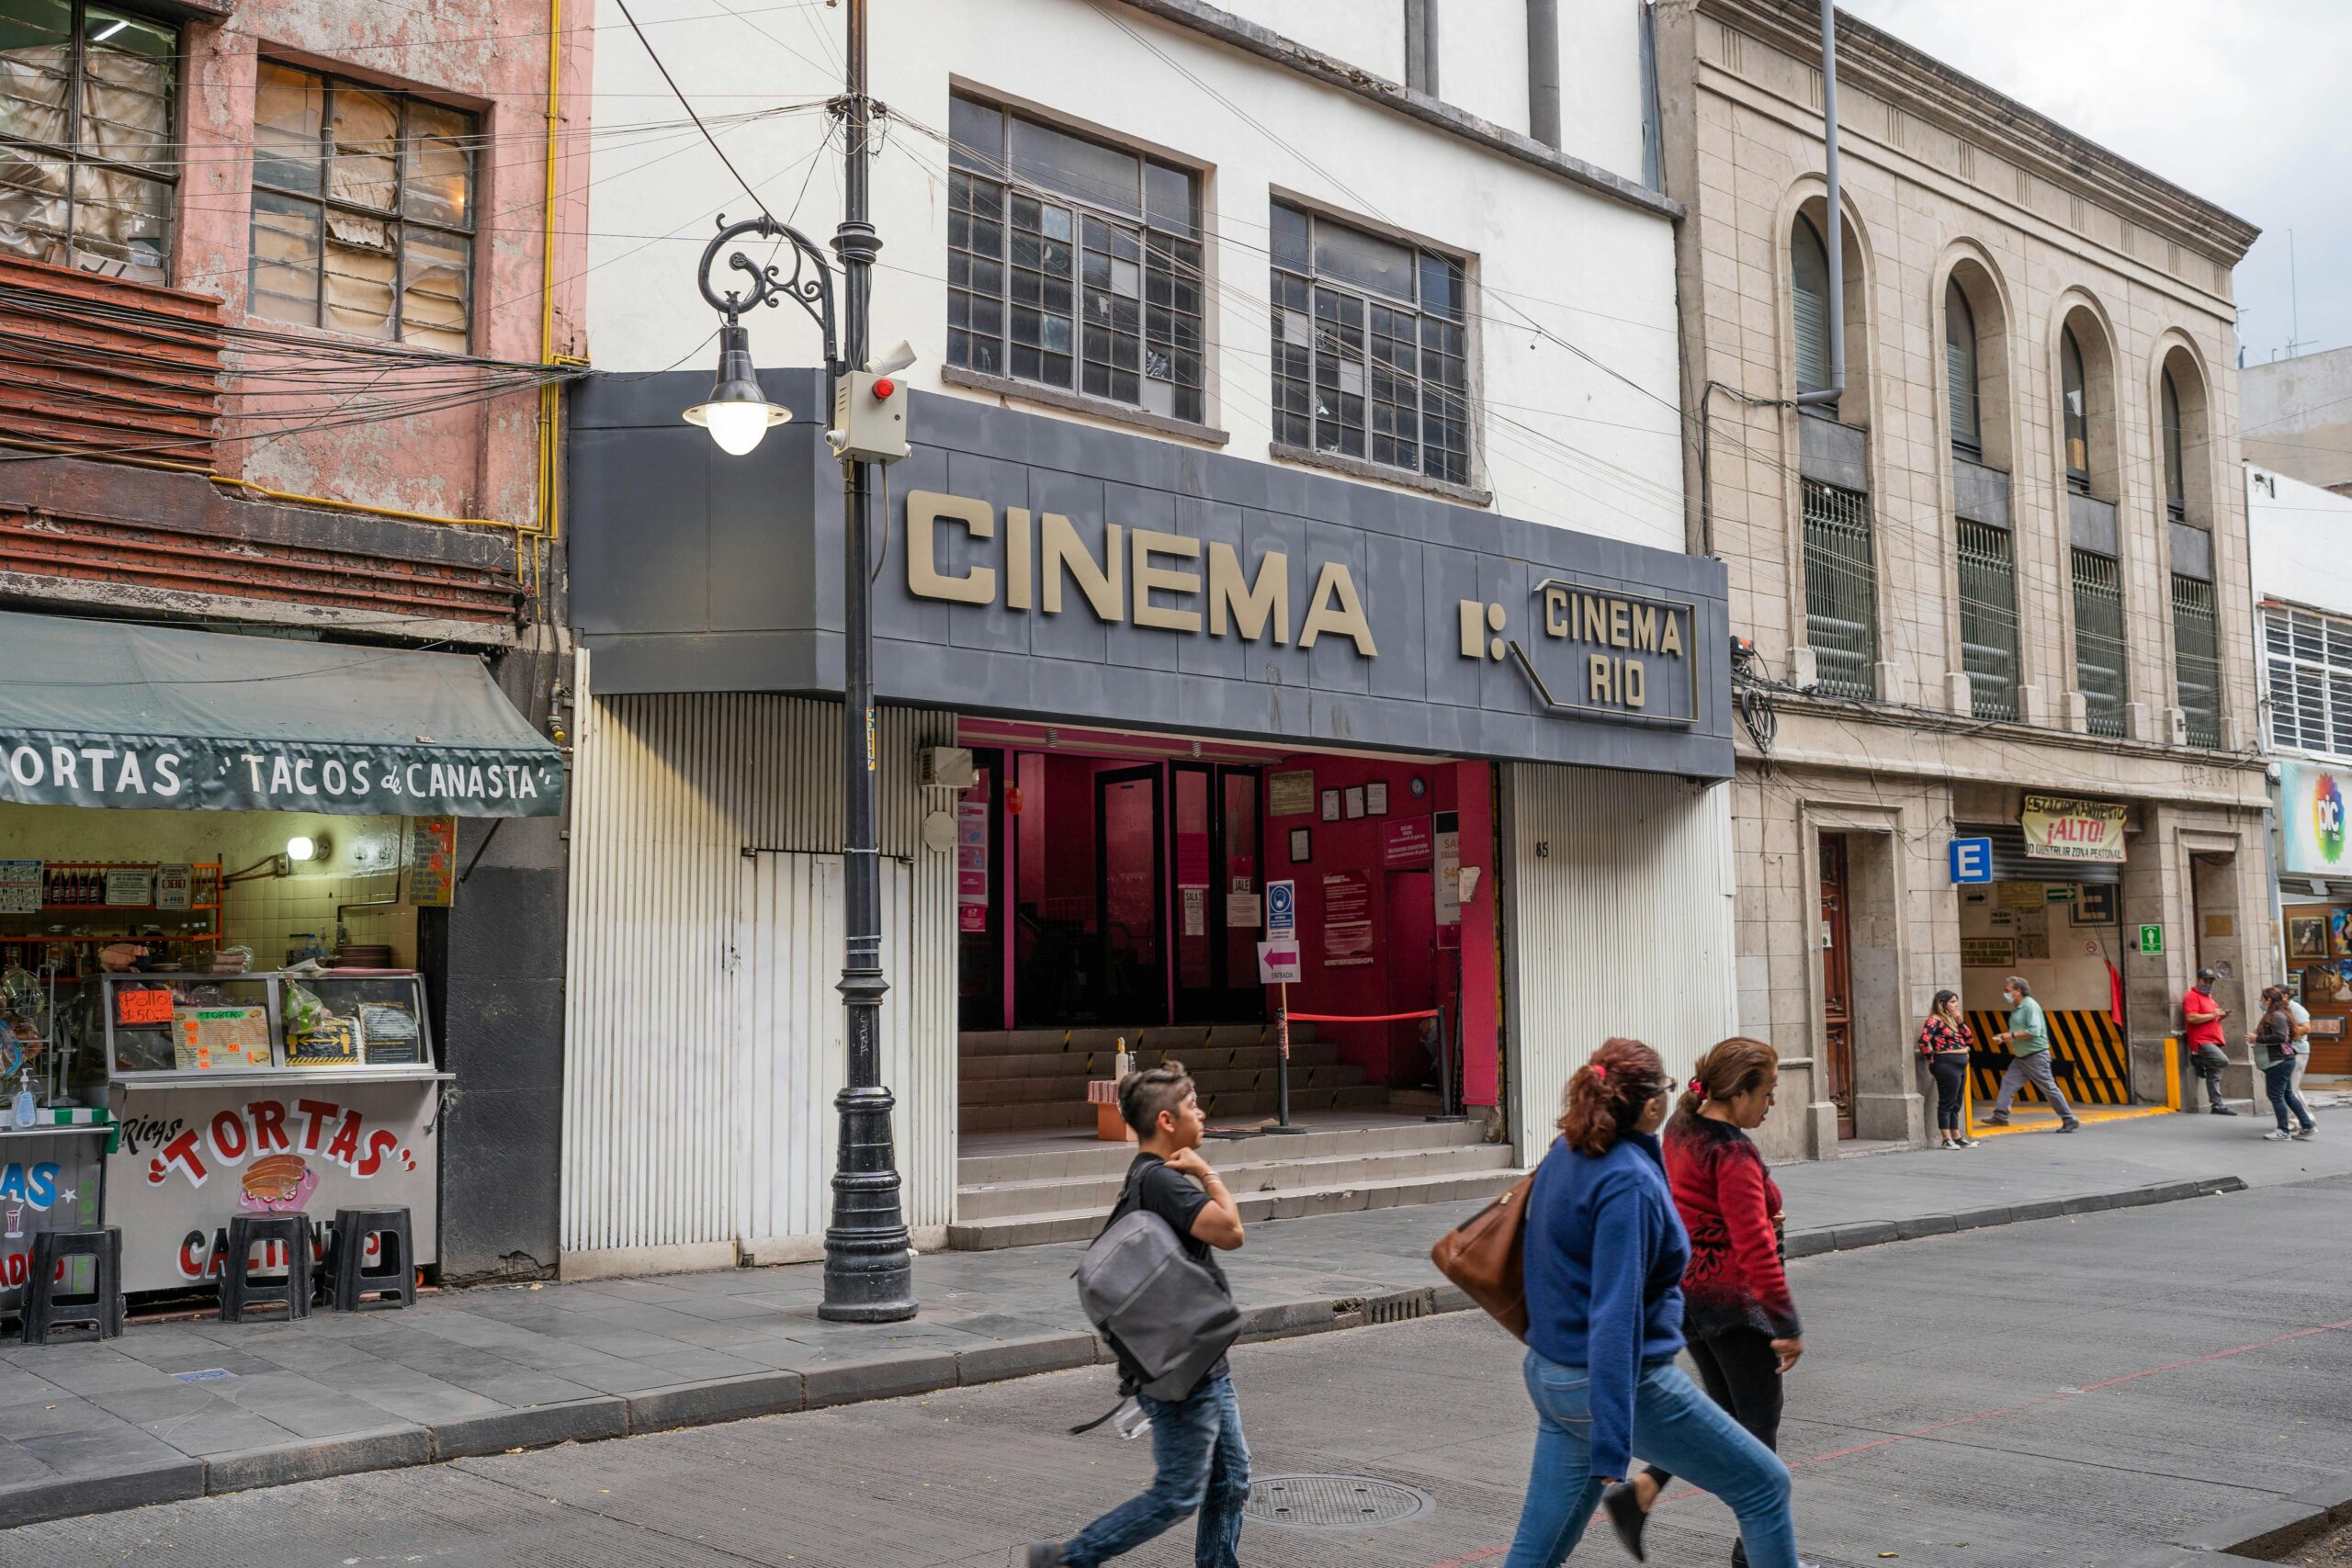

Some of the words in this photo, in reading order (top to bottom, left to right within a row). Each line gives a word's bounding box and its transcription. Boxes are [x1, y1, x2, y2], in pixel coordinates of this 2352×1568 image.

[907, 489, 1378, 658] CINEMA
[1546, 587, 1683, 656] CINEMA
[1590, 653, 1645, 706] RIO
[0, 745, 182, 796] ORTAS
[381, 765, 402, 795] de
[2182, 765, 2215, 786] CUBA
[2317, 794, 2339, 838] pic
[2047, 818, 2106, 844] ¡ALTO!
[1958, 844, 1982, 877] E
[2036, 844, 2070, 856] OBSTRUIR
[2072, 847, 2088, 858] ZONA
[2090, 849, 2123, 859] PEATONAL
[1235, 880, 1249, 891] JALE
[1272, 971, 1293, 979] ENTRADA
[125, 991, 167, 1008] Pollo
